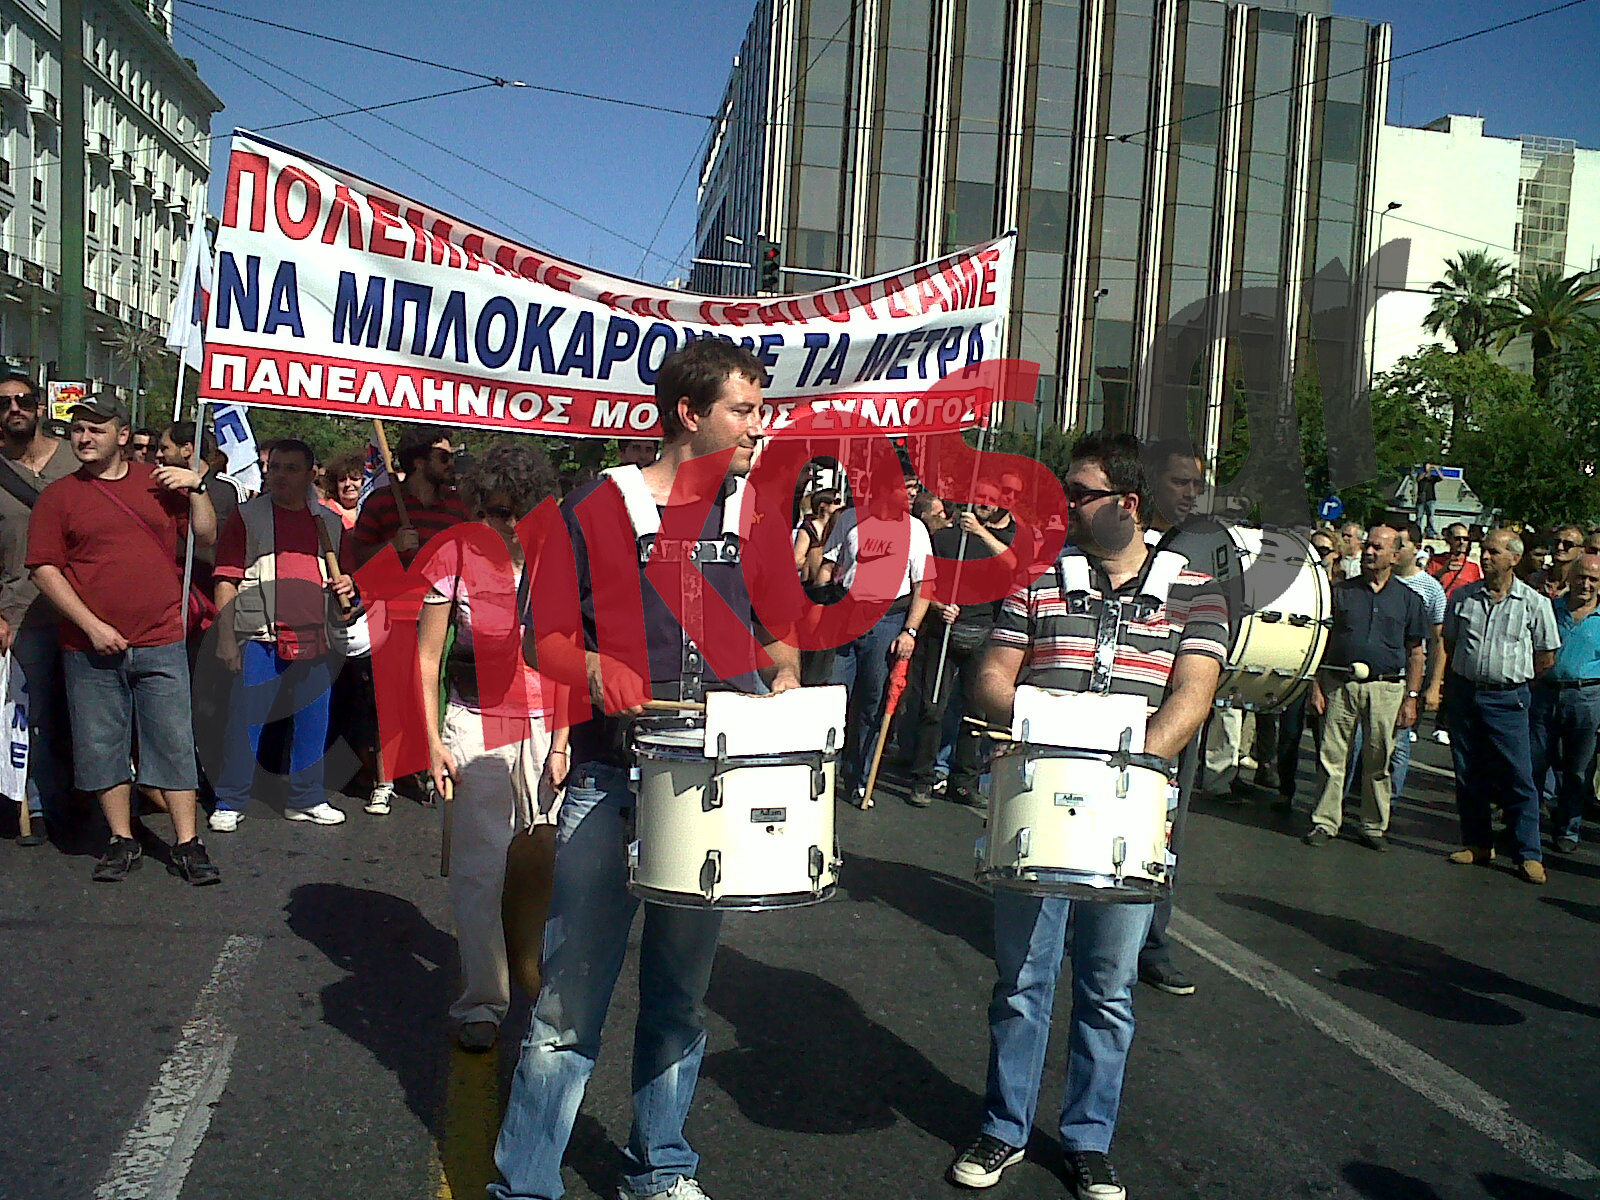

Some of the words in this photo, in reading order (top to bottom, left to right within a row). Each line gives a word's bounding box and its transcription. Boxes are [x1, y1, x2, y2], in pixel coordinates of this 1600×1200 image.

[215, 250, 305, 339] ΝΑ
[332, 270, 785, 390] ΜΠΛΟΚΑΡΟΕ
[795, 332, 850, 388] ΤΑ
[853, 322, 984, 383] ΜΕΤΡΑ
[210, 352, 575, 425] ΠΑΝΕΛΛΗΝΙΟΣ
[810, 394, 977, 430] ΣΥΛΛΟΓΟΣ
[863, 537, 895, 554] NIKE
